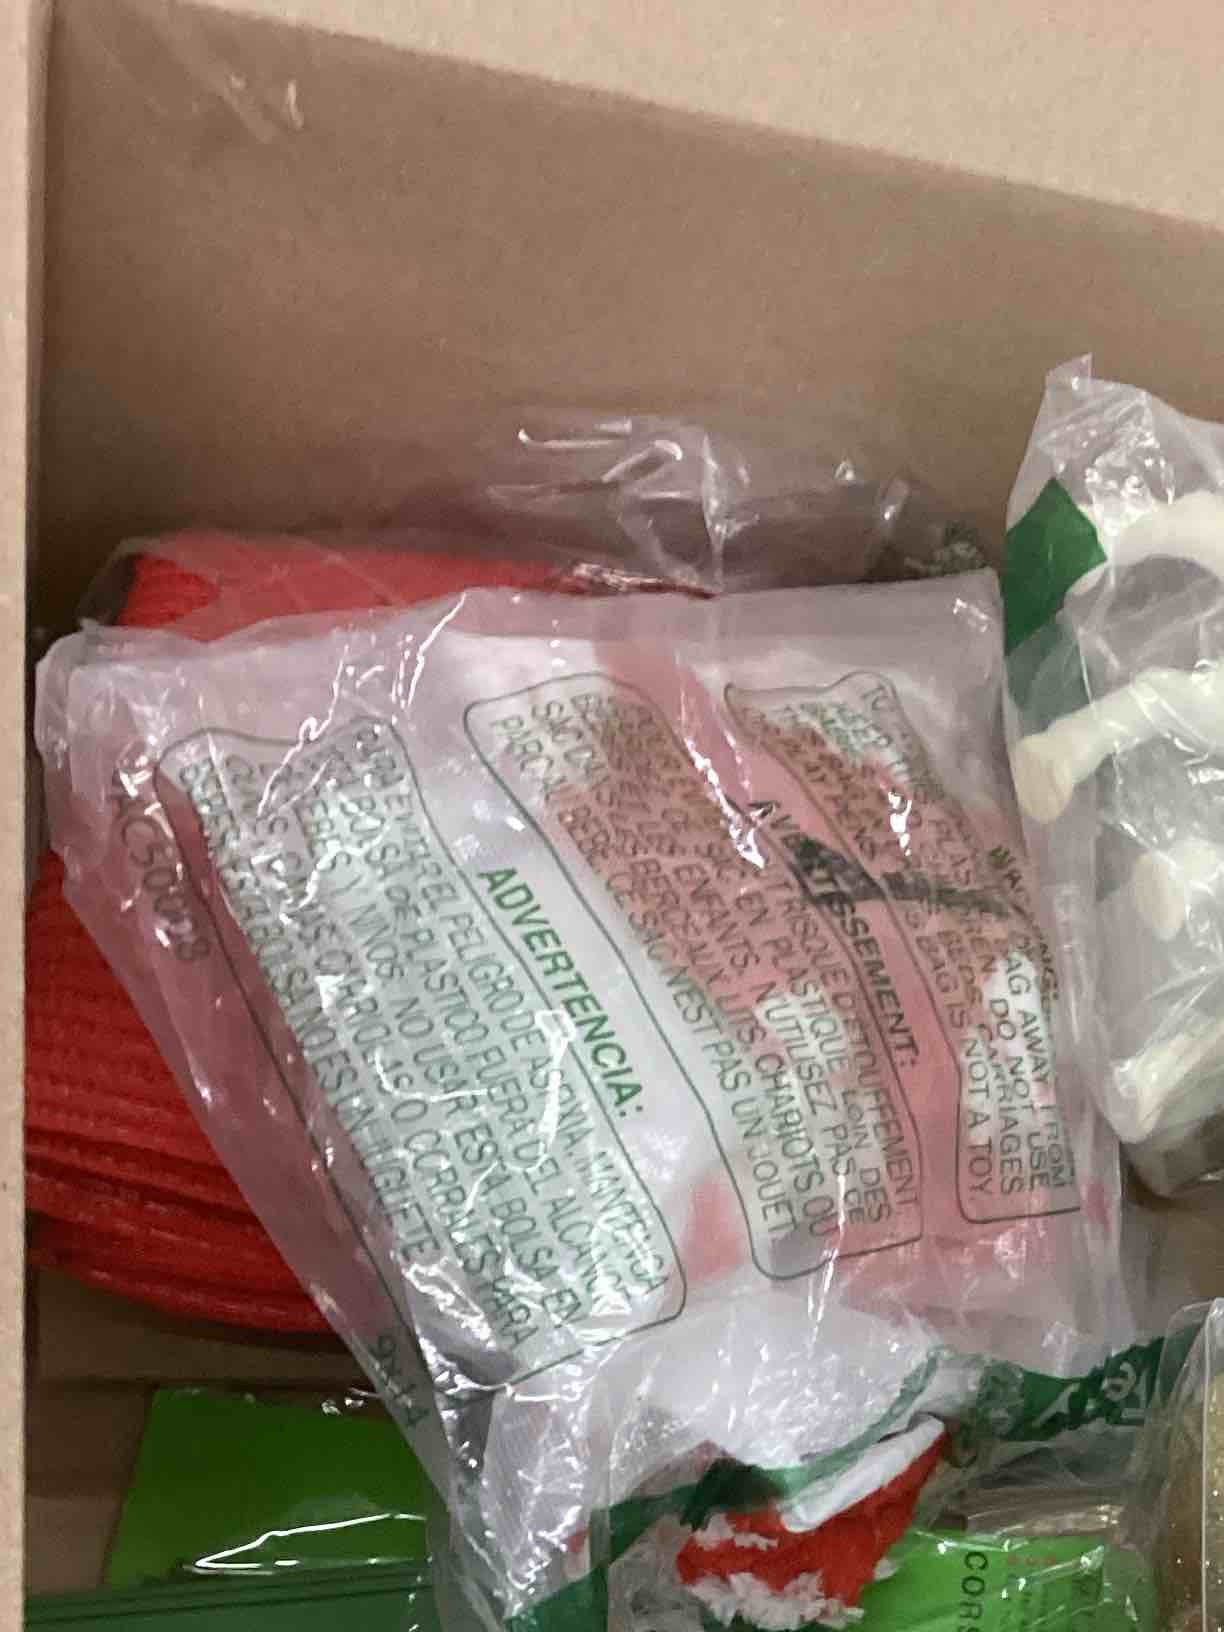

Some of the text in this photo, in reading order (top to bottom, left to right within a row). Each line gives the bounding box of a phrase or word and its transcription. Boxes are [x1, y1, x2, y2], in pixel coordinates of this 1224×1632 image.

[475, 871, 650, 1122] ADVERTENCIA:
[499, 1008, 544, 1053] DE
[945, 1003, 970, 1029] IS
[965, 1038, 991, 1098] NOT
[1017, 1010, 1052, 1087] AWAY
[701, 1039, 752, 1095] PAS
[731, 1099, 764, 1137] UN
[967, 1112, 989, 1129] A
[988, 1000, 1048, 1190] DO NOT USE
[754, 1054, 825, 1193] CHARIOTS
[802, 1193, 838, 1240] OU
[824, 1124, 857, 1177] PAS
[858, 1165, 894, 1224] DES
[490, 1196, 561, 1286] BOLSA
